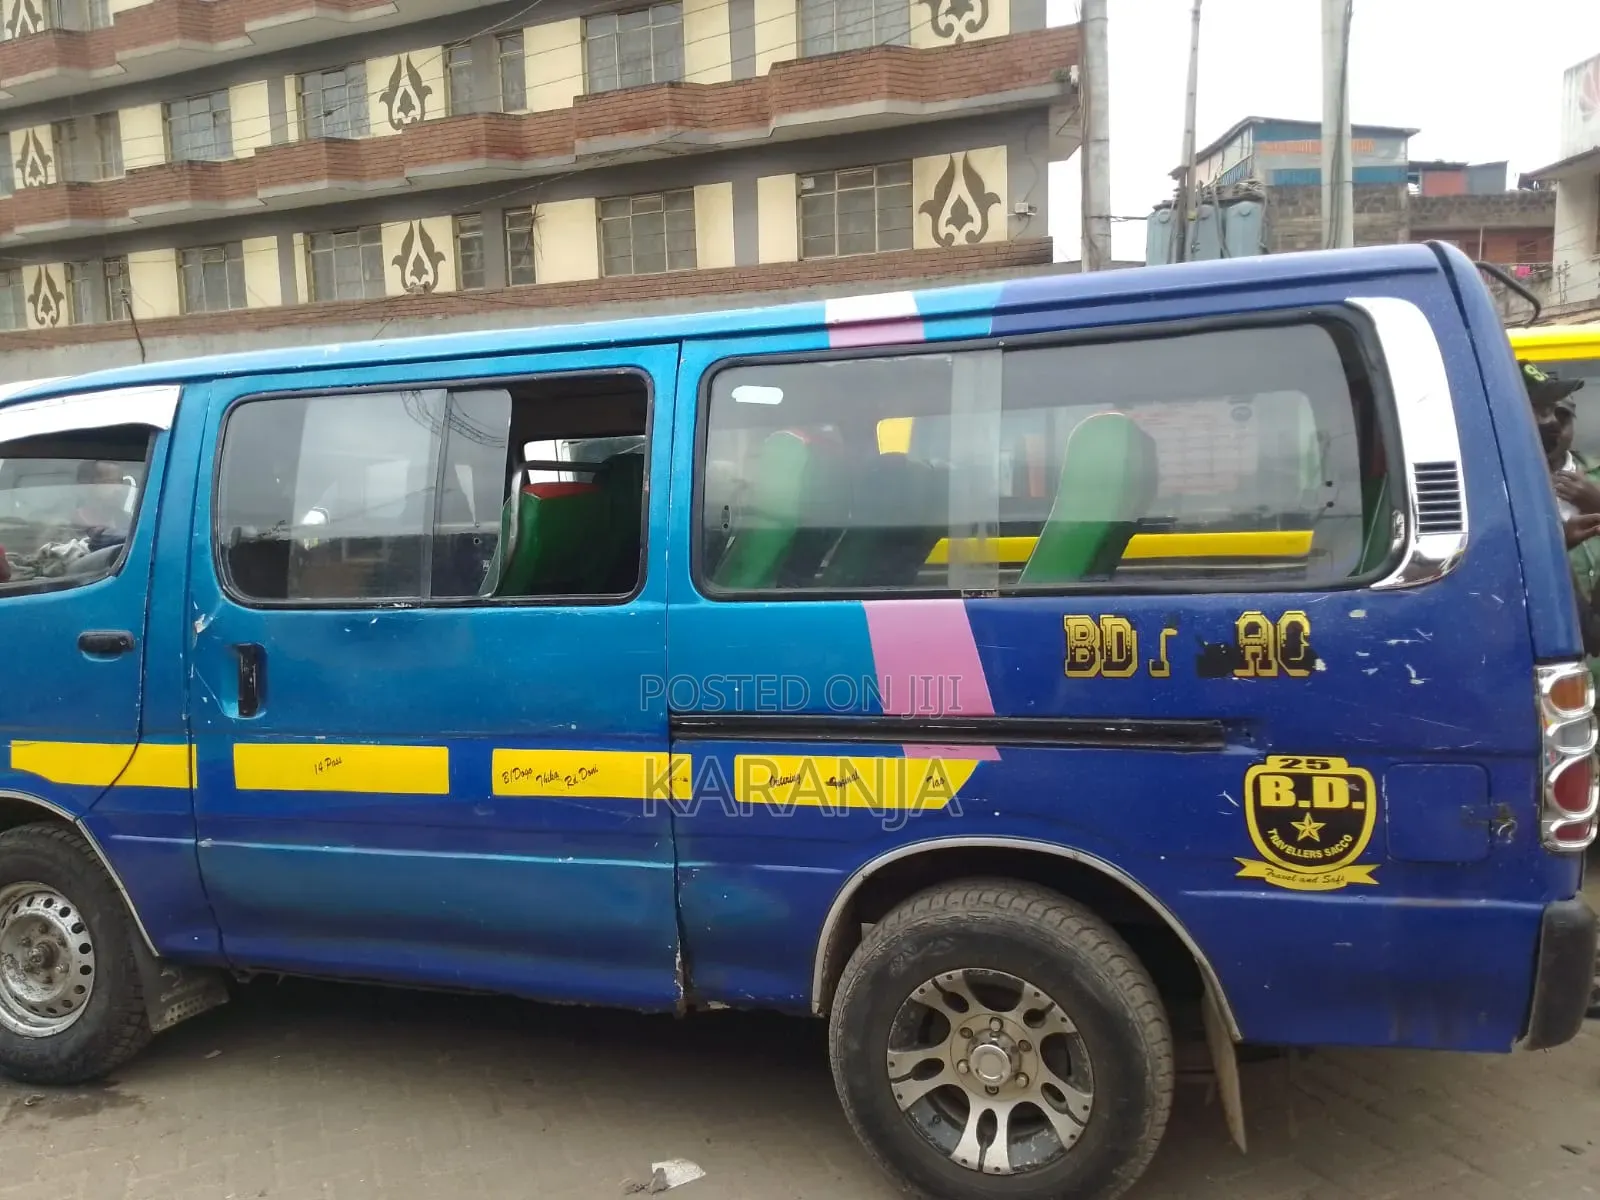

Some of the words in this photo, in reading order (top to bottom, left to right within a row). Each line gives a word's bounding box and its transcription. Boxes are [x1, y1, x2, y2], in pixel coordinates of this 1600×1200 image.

[1064, 614, 1138, 678] BD
[314, 761, 323, 775] 14
[1279, 758, 1332, 770] 25
[1259, 775, 1365, 809] B.D.
[1267, 828, 1323, 859] TRAVELLERS
[1324, 834, 1353, 857] SACCO
[1265, 867, 1297, 882] Travel
[1299, 876, 1319, 884] and
